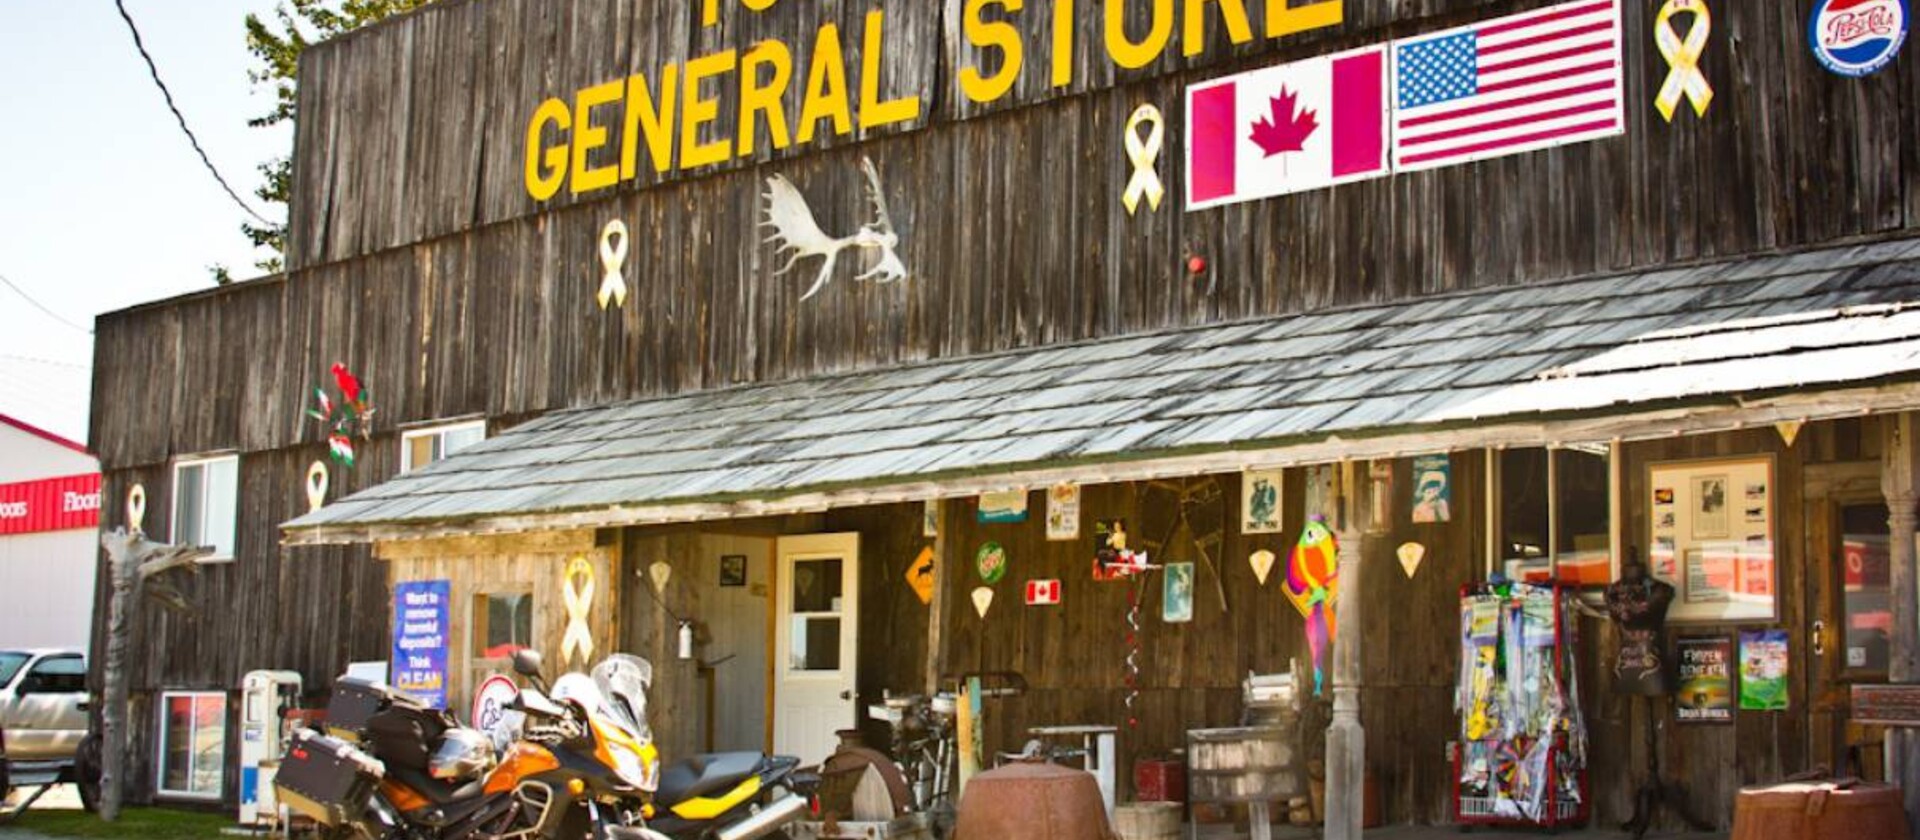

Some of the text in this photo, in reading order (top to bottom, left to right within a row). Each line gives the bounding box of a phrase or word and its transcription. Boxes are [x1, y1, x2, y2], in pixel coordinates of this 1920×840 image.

[525, 10, 920, 201] GENERAL
[0, 502, 27, 518] oors
[408, 656, 432, 669] Think
[1683, 649, 1722, 663] FROZEN
[398, 671, 443, 690] CLEAN
